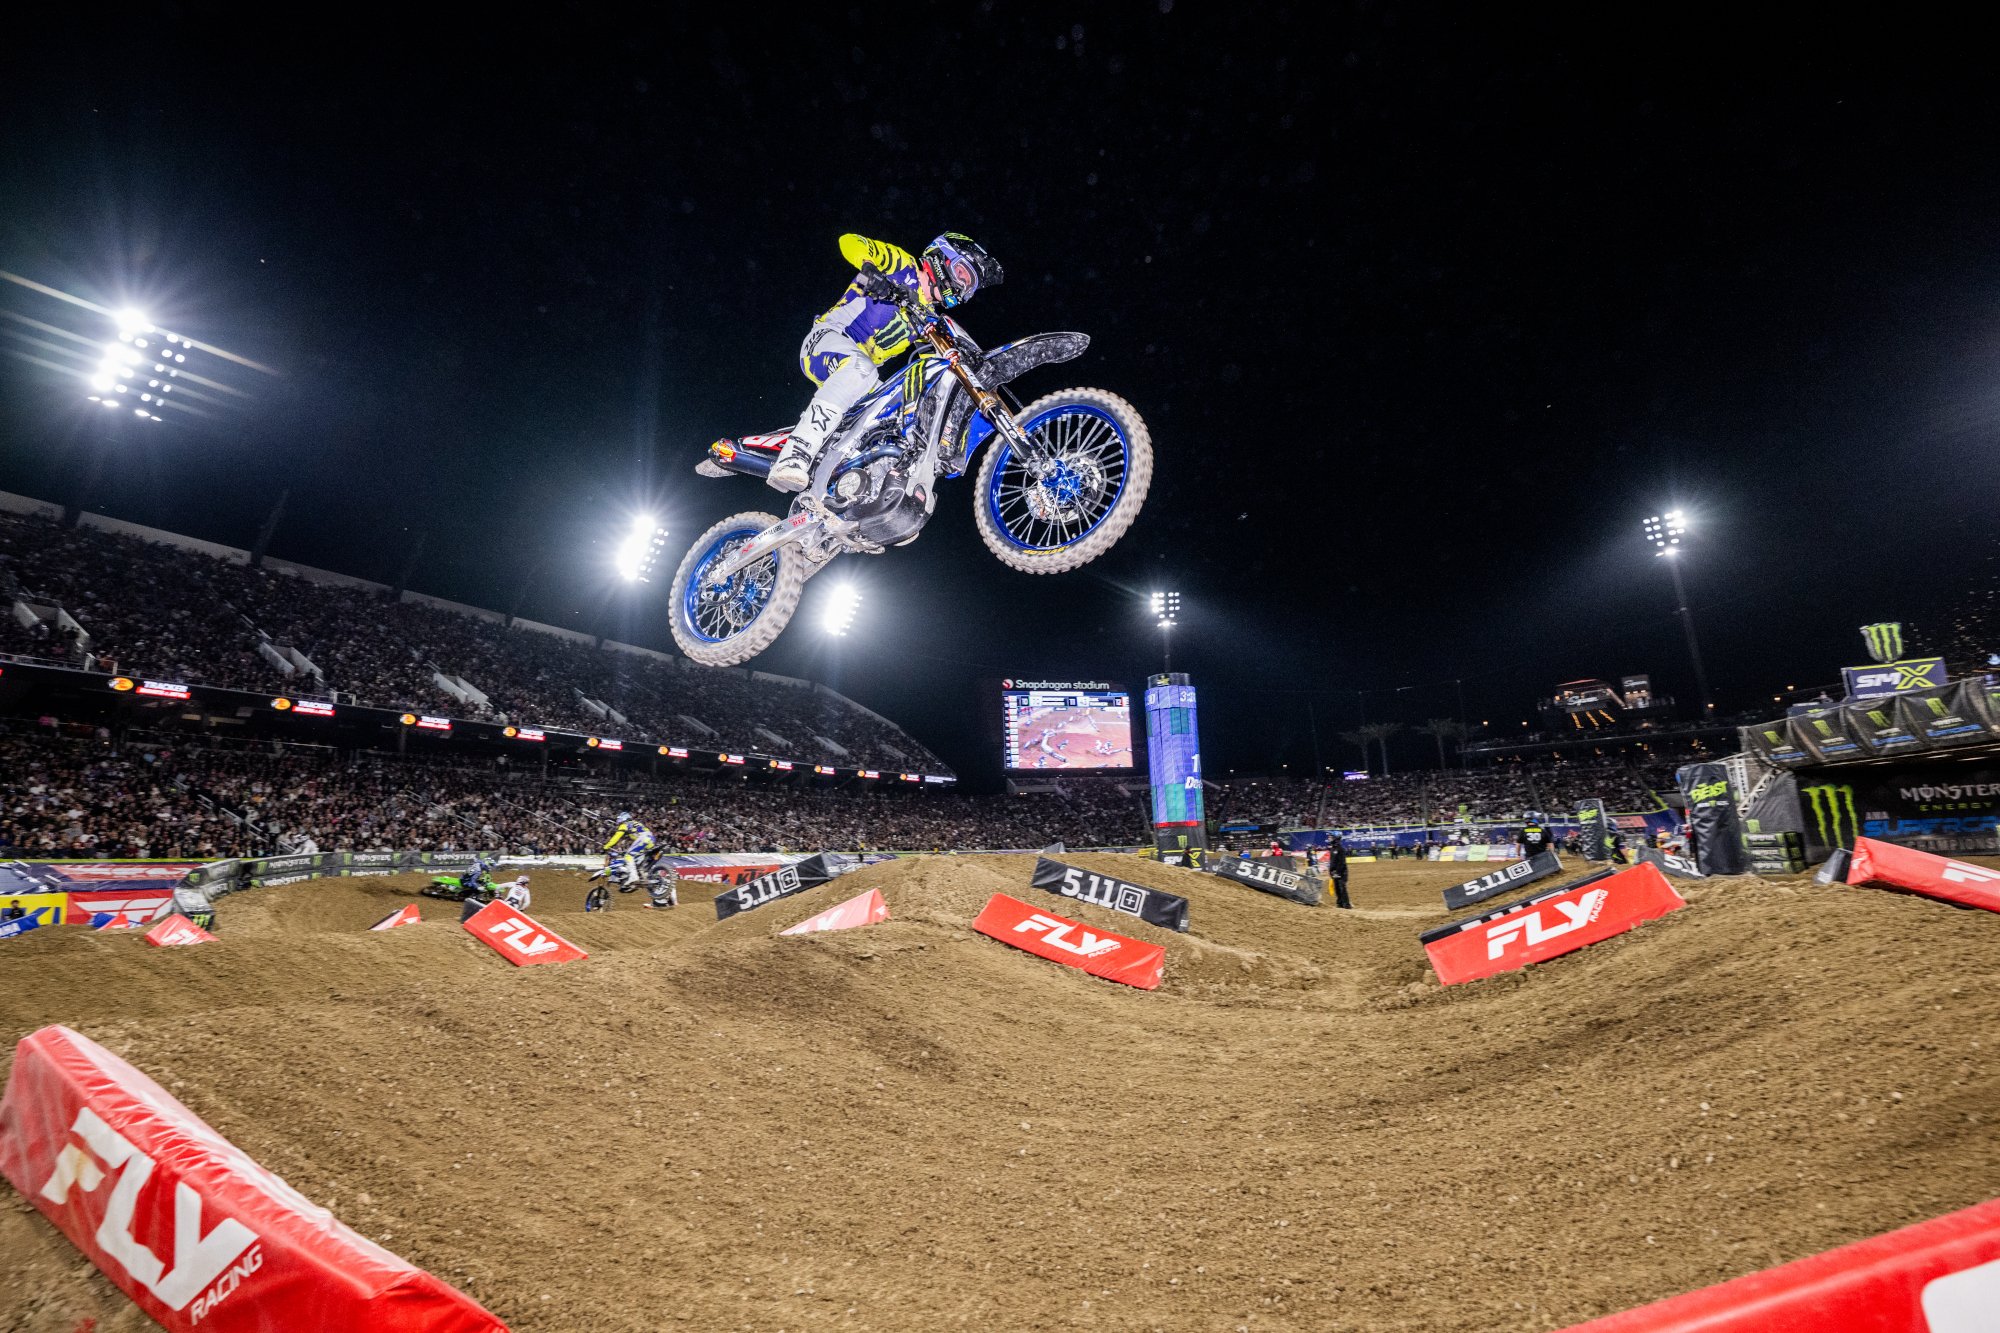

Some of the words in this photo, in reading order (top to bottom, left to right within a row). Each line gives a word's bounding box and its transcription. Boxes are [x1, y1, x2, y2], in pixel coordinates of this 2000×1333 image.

[1015, 679, 1072, 691] Snapdragon
[1073, 681, 1110, 690] stadium
[1855, 663, 1937, 690] SMX
[1901, 783, 2000, 801] MONSTER
[1919, 802, 1992, 811] ENERGY
[1526, 833, 1541, 841] 30
[268, 858, 310, 869] MONSTER
[353, 853, 391, 862] MONSTER
[1235, 860, 1278, 885] 5.11
[1463, 870, 1510, 896] 5.11
[736, 871, 781, 910] 5.11
[1060, 867, 1117, 909] 5.11
[1588, 888, 1609, 923] RACING
[488, 917, 560, 955] FLY
[1012, 913, 1121, 955] FLY
[1486, 888, 1602, 961] FLY
[1088, 942, 1122, 958] RACING
[40, 1106, 260, 1312] FLY
[190, 1244, 264, 1326] RACING
